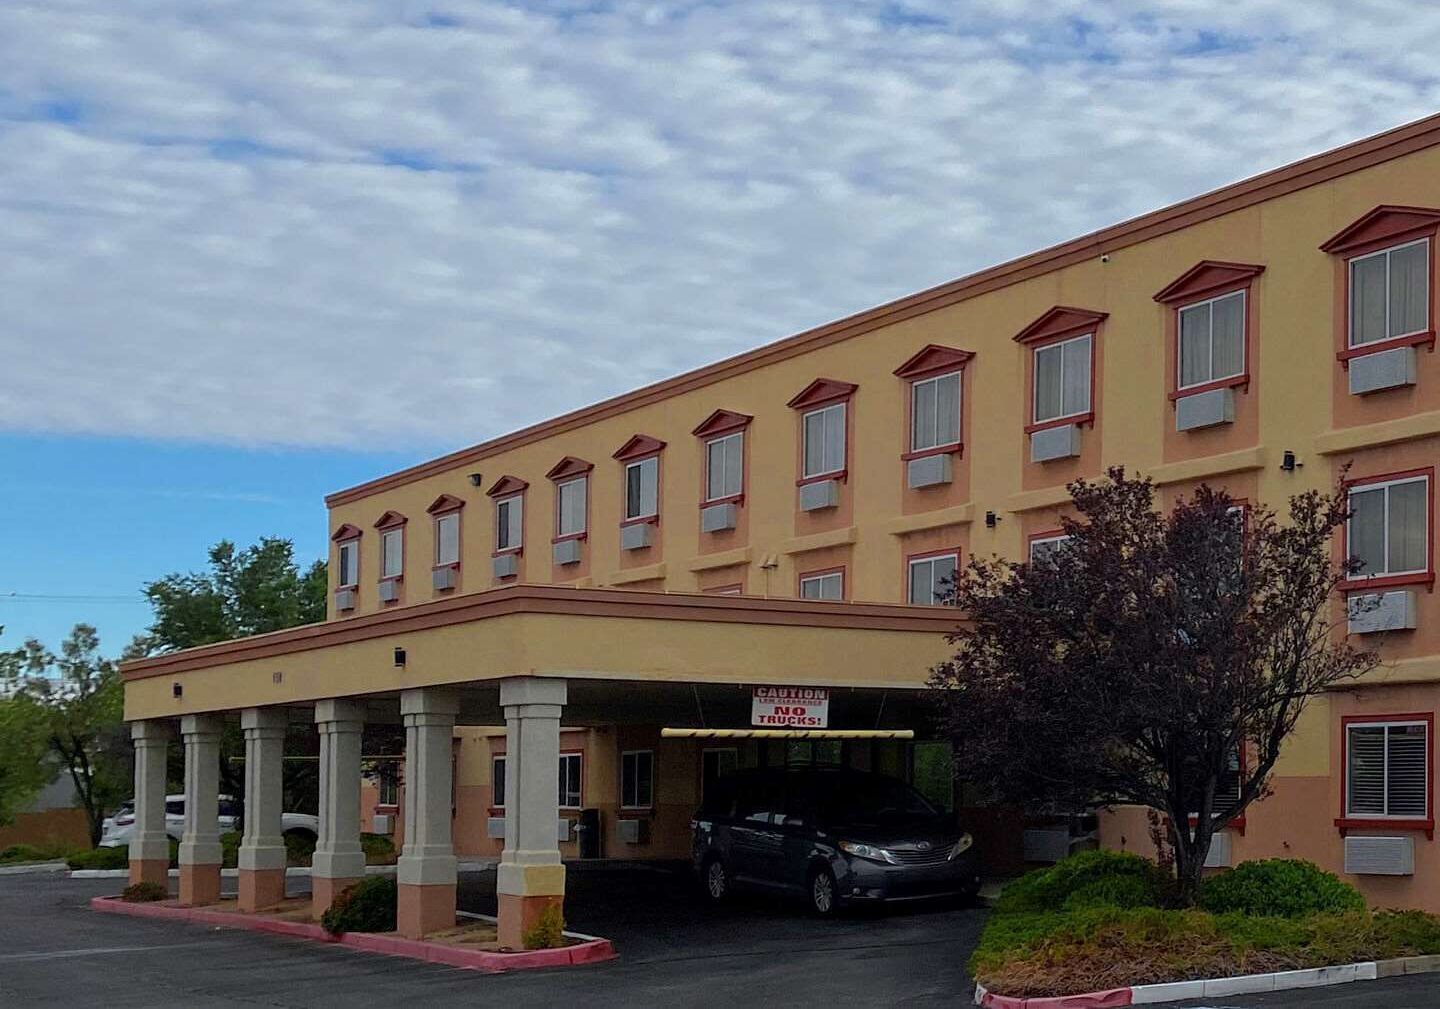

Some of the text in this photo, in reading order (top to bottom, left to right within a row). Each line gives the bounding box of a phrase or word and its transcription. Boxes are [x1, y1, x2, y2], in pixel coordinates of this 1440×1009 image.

[757, 687, 825, 699] CAUTION
[774, 706, 806, 716] NO
[758, 715, 821, 725] TRUCKS!
